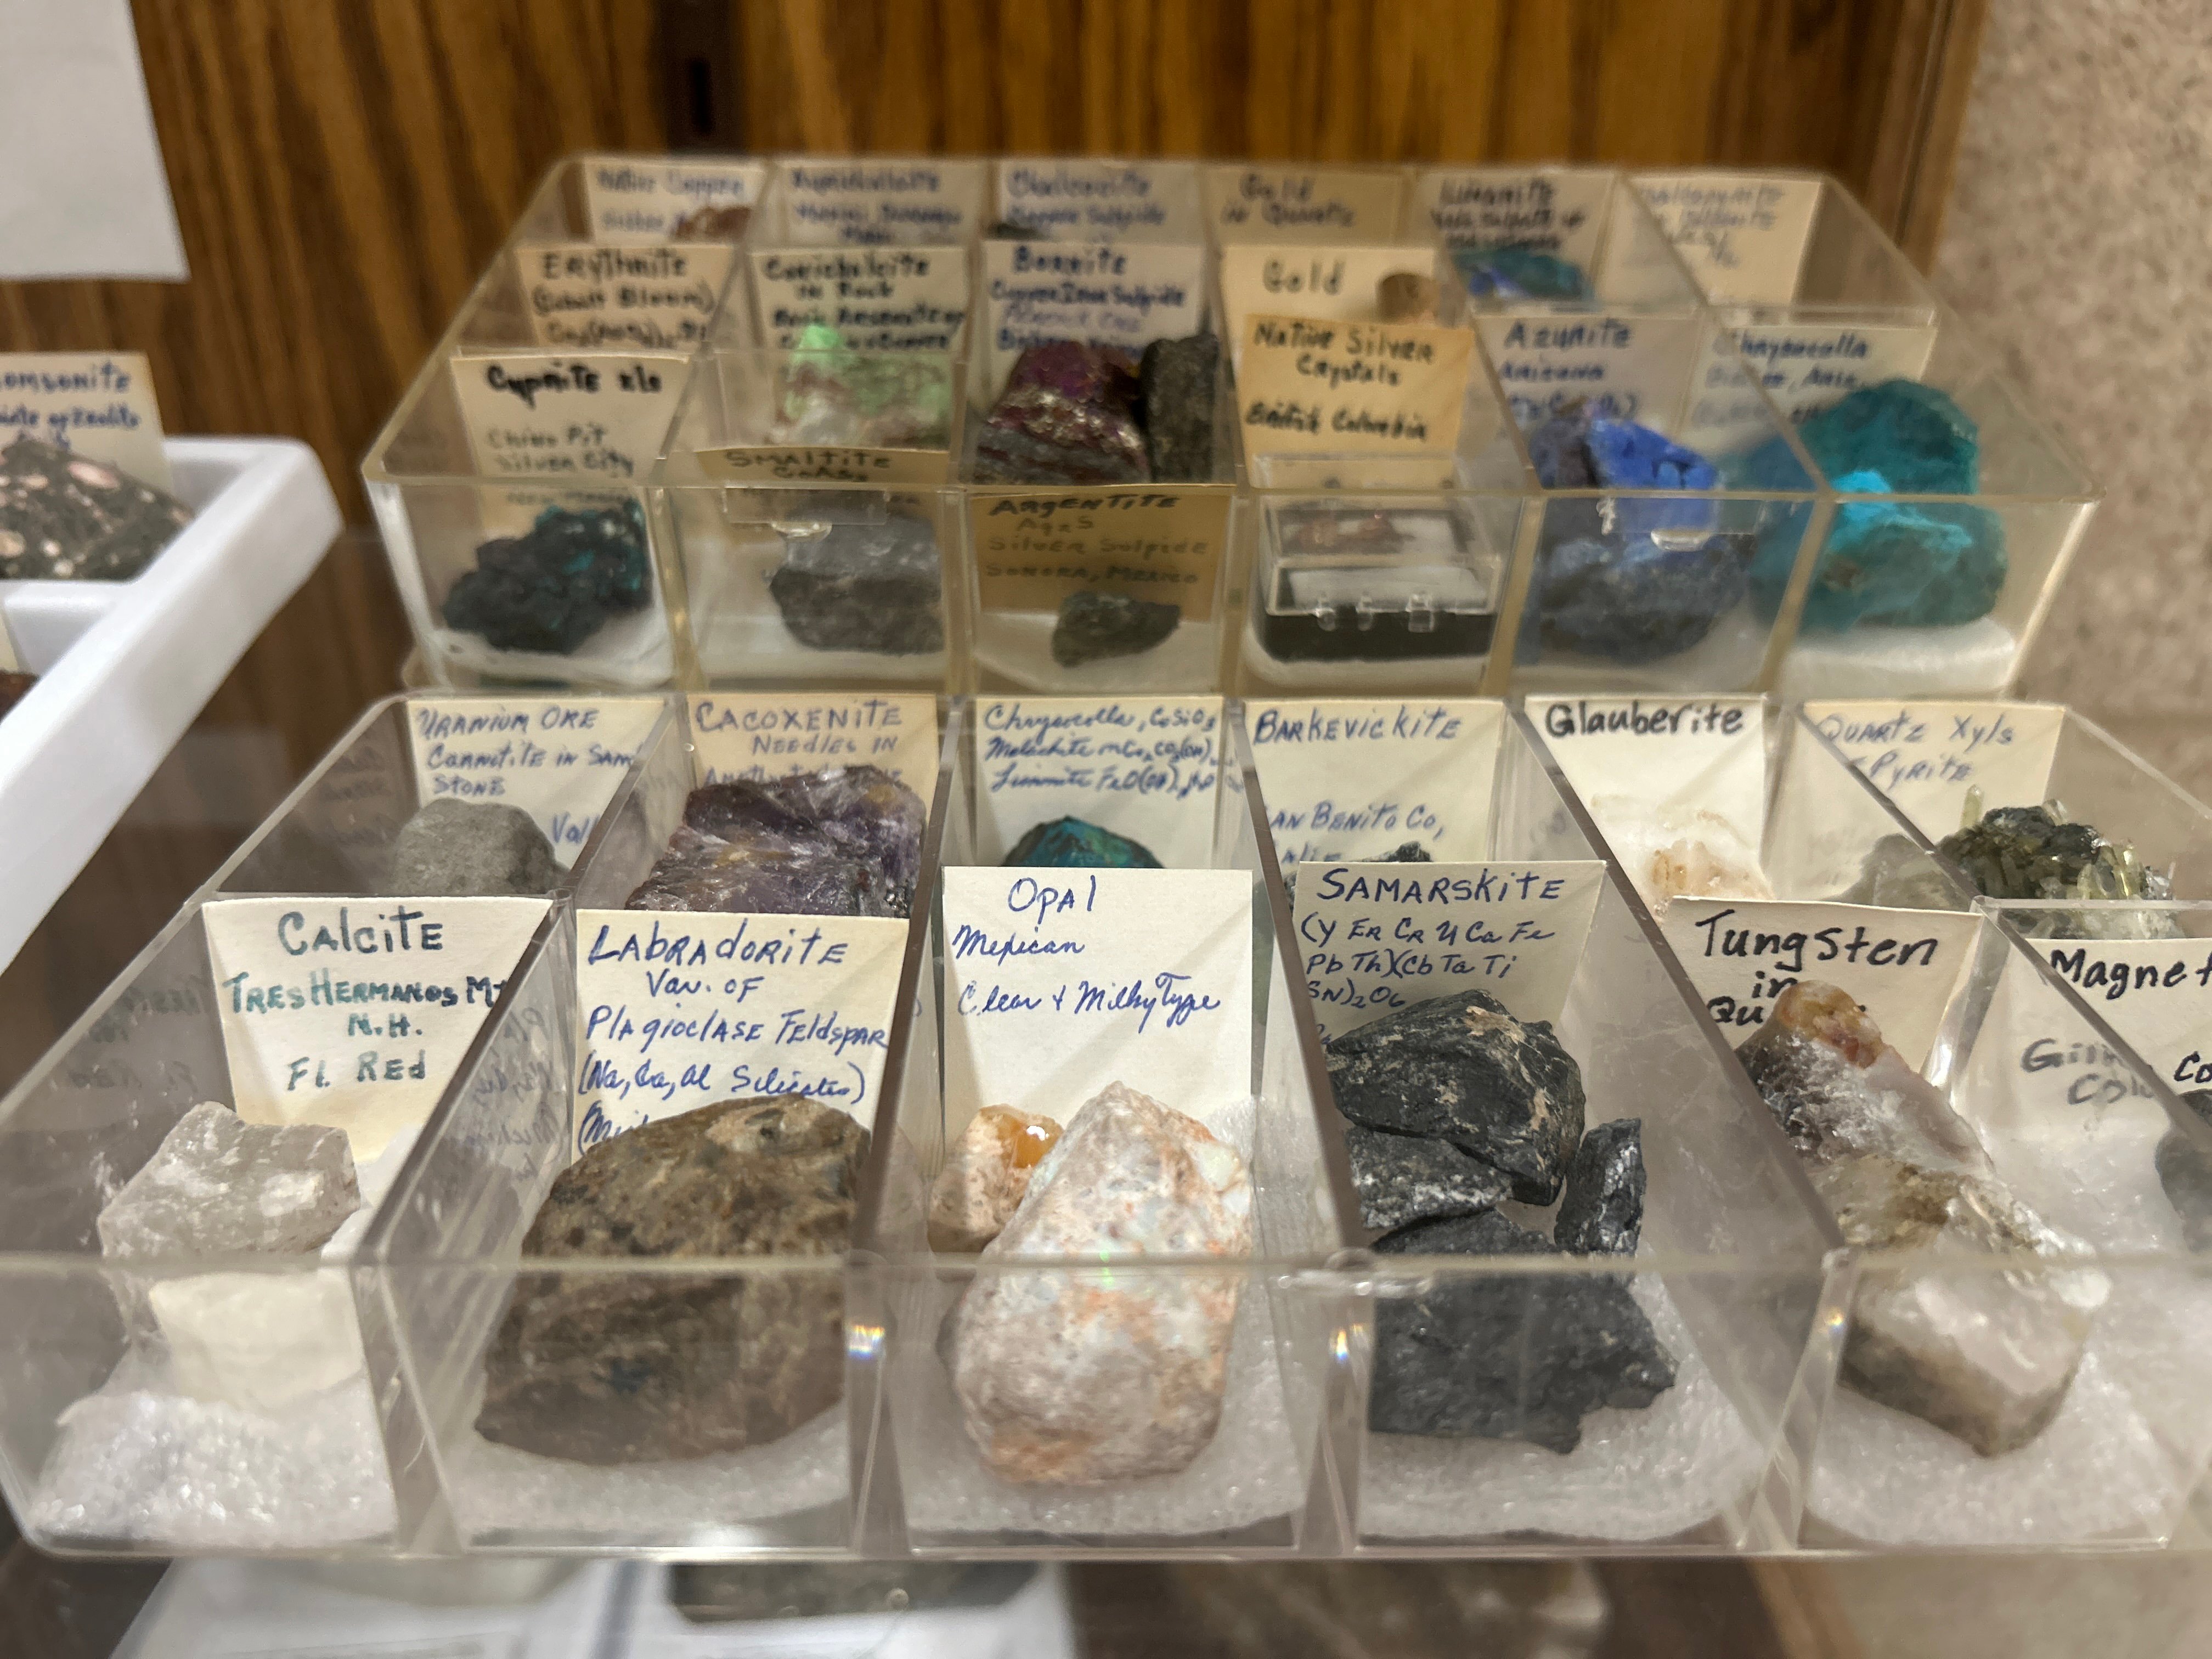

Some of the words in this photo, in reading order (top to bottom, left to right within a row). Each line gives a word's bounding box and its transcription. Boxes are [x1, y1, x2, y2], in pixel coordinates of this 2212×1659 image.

[1263, 255, 1345, 294] Gold
[1545, 699, 1743, 738] Glauberite
[1695, 909, 1939, 973] Tungsten
